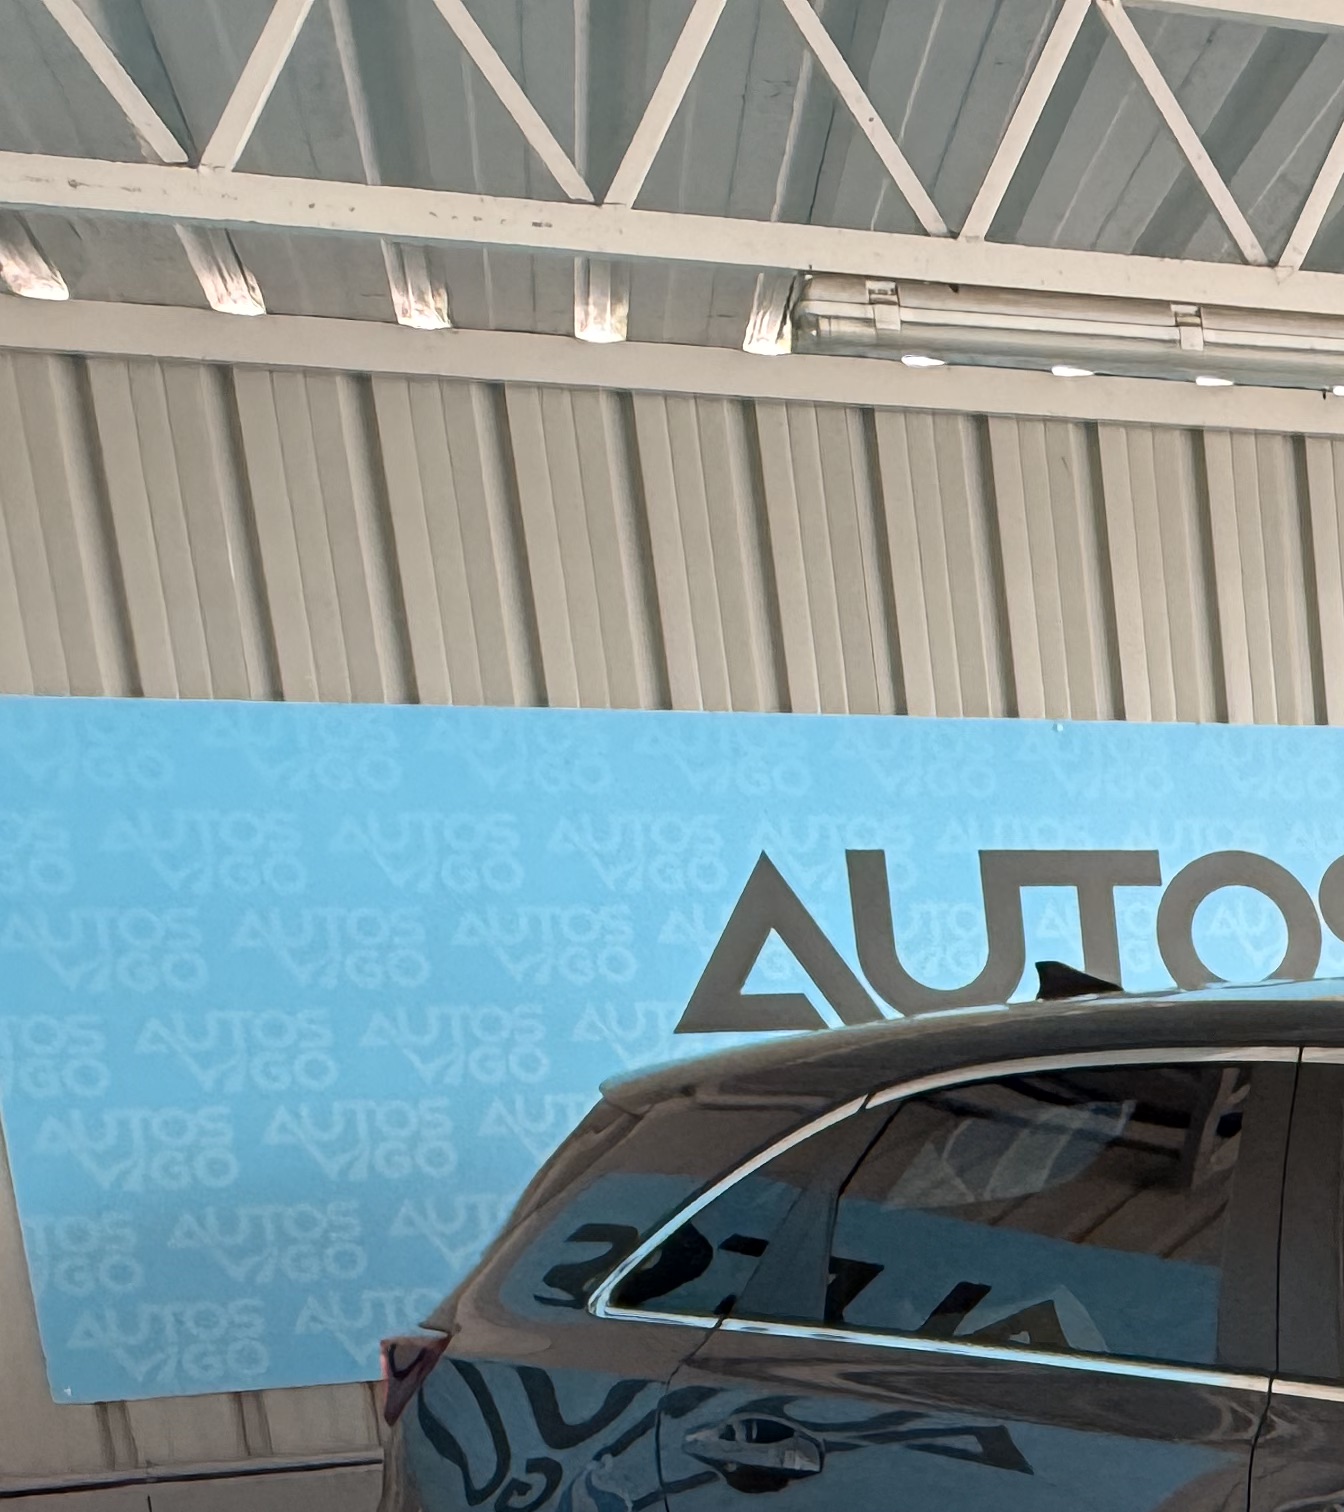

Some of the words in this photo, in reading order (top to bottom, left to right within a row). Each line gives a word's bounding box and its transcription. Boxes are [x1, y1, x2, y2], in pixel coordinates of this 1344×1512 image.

[102, 808, 302, 851] AUTOS
[330, 811, 520, 852] AUTOS
[546, 812, 723, 852] AUTOS
[148, 851, 306, 896] VIGO
[370, 850, 524, 893] VIGO
[583, 850, 728, 892] VIGO
[0, 905, 202, 948] AUTOS
[231, 905, 426, 948] AUTOS
[451, 903, 635, 946] AUTOS
[40, 948, 209, 993] VIGO
[275, 948, 431, 990] VIGO
[494, 945, 638, 985] VIGO
[134, 1010, 333, 1054] AUTOS
[358, 1004, 547, 1048] AUTOS
[175, 1050, 339, 1093] VIGO
[400, 1045, 551, 1087] VIGO
[33, 1105, 234, 1153] AUTOS
[259, 1098, 452, 1145] AUTOS
[74, 1150, 240, 1192] VIGO
[300, 1140, 458, 1182] VIGO
[167, 1200, 361, 1249] AUTOS
[210, 1244, 368, 1285] VIGO
[65, 1299, 266, 1349] AUTOS
[112, 1339, 270, 1383] VIGO
